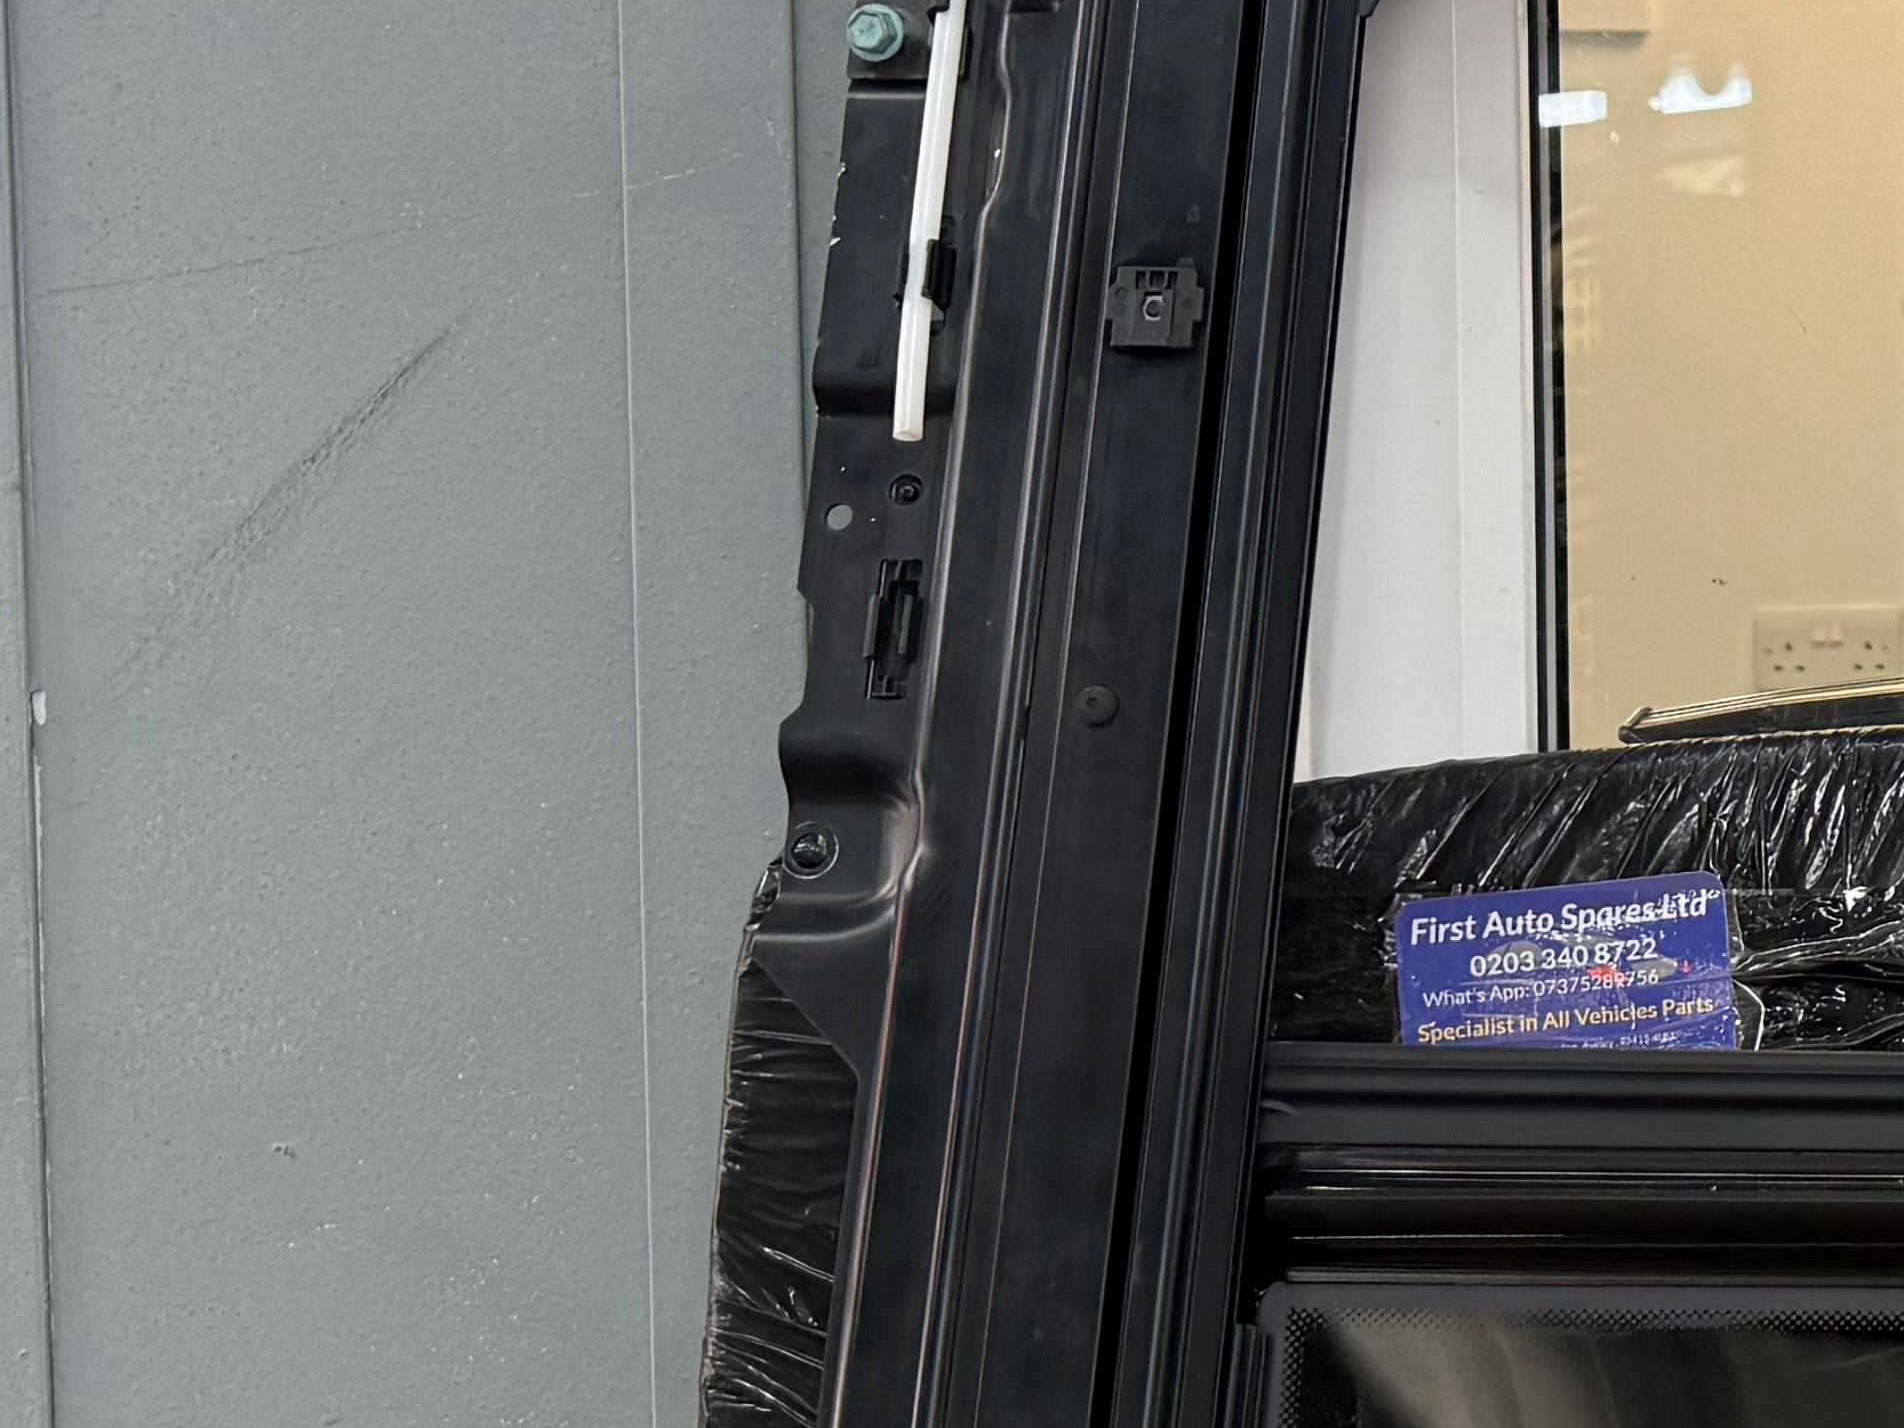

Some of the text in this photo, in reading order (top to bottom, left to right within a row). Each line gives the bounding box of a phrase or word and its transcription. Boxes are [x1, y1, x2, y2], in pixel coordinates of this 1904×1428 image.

[1410, 889, 1708, 945] First Auto Spares Ltd
[1469, 937, 1660, 977] 0203 340 8722
[1422, 986, 1486, 1008] What's
[1489, 984, 1531, 1003] App:
[1417, 997, 1714, 1045] Specialist in All Vehicles Parts
